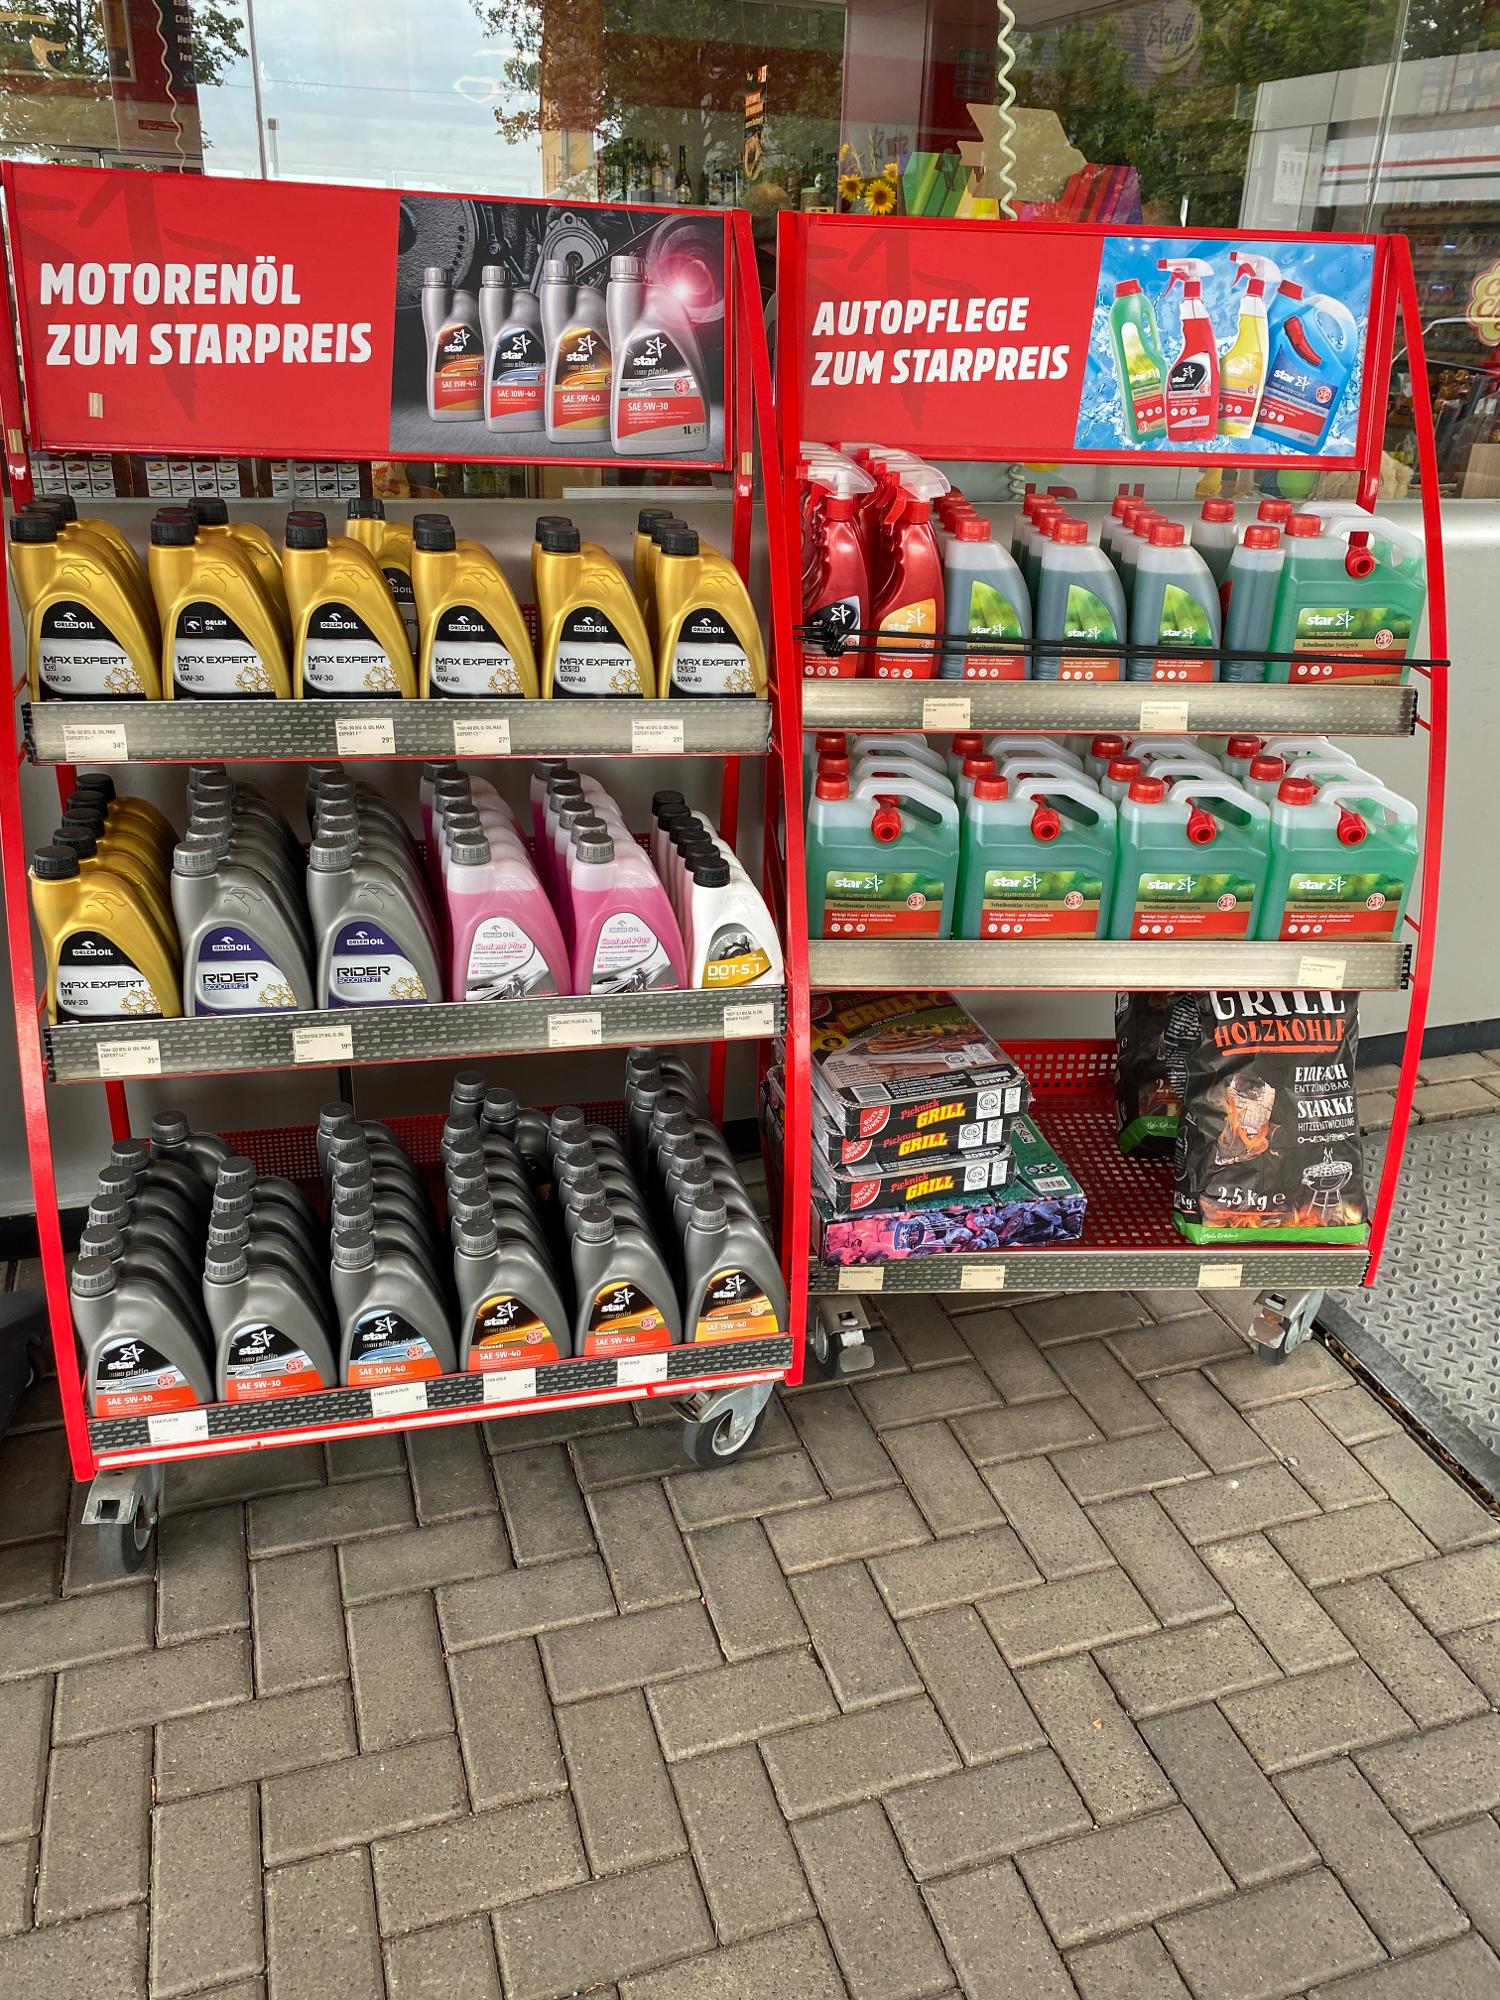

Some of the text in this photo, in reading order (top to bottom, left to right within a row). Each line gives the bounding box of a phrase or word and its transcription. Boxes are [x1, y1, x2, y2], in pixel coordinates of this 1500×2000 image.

[41, 256, 301, 305] MOTORENÖL
[812, 297, 1029, 335] AUTOPFLEGE
[47, 322, 372, 366] ZUM STARPREIS
[444, 343, 464, 353] star
[501, 351, 524, 361] star
[566, 352, 590, 362] star
[633, 356, 659, 366] star
[811, 344, 1070, 385] ZUM STARPREIS
[1273, 368, 1296, 384] star
[498, 390, 536, 398] SAE 10W-40
[562, 394, 600, 404] SAE 5W-40
[628, 402, 669, 412] SAE 5W-30
[54, 621, 96, 629] ORLEN OIL
[320, 621, 343, 629] ORLEN
[1305, 614, 1334, 626] star
[449, 624, 486, 632] ORLEN OIL
[573, 625, 609, 633] ORLEN OIL
[712, 626, 726, 634] OIL
[887, 621, 911, 632] star
[971, 625, 992, 635] star
[1067, 629, 1088, 638] star
[1162, 628, 1182, 637] star
[43, 655, 127, 665] MAX EXPERT
[177, 655, 257, 664] MAX EXPERT
[308, 655, 386, 664] MAX EXPERT
[435, 657, 511, 666] MAX EXPERT
[559, 657, 632, 667] MAX EXPERT
[677, 658, 747, 667] MAX EXPERT
[46, 675, 72, 683] 5W-30
[180, 674, 205, 682] 5W-30
[309, 674, 334, 682] 5W-30
[436, 675, 460, 683] 5W-40
[560, 675, 587, 683] 10W-40
[834, 878, 863, 889] star
[992, 876, 1021, 888] star
[1146, 879, 1176, 891] star
[1297, 879, 1326, 890] star
[236, 943, 252, 951] OIL
[370, 938, 385, 946] OIL
[97, 948, 114, 956] OIL
[336, 965, 392, 977] RIDER
[707, 962, 761, 977] DOT-5.1
[203, 971, 259, 984] RIDER
[337, 976, 371, 984] SCOOTER
[60, 979, 145, 989] MAX EXPERT
[1210, 991, 1345, 1020] GRILL
[1295, 1064, 1348, 1082] EINFACH
[975, 1076, 1010, 1086] EDEKA
[1294, 1080, 1351, 1093] ENTZÜNDBAR
[901, 1098, 940, 1120] Picknick
[1297, 1096, 1354, 1119] STARKE
[863, 1108, 886, 1132] GÜNSTIG
[916, 1102, 966, 1129] GRILL
[1297, 1118, 1355, 1132] HITZEENTWICKLUNG
[883, 1131, 923, 1148] Picknick
[898, 1132, 949, 1157] GRILL
[964, 1149, 1000, 1160] EDEKA
[890, 1173, 929, 1193] Picknick
[905, 1175, 955, 1201] GRILL
[1217, 1186, 1268, 1212] 2,5 kg
[713, 1290, 737, 1299] star
[600, 1303, 626, 1313] star
[484, 1317, 510, 1327] star
[362, 1332, 389, 1342] star
[595, 1335, 636, 1346] SAE 5W-40
[238, 1345, 266, 1356] star
[479, 1349, 522, 1361] SAE 5W-40
[107, 1360, 136, 1370] star
[358, 1364, 406, 1376] SAE 10W-40
[236, 1379, 282, 1391] SAE 5W-30
[106, 1394, 154, 1406] SAE 5W-30
